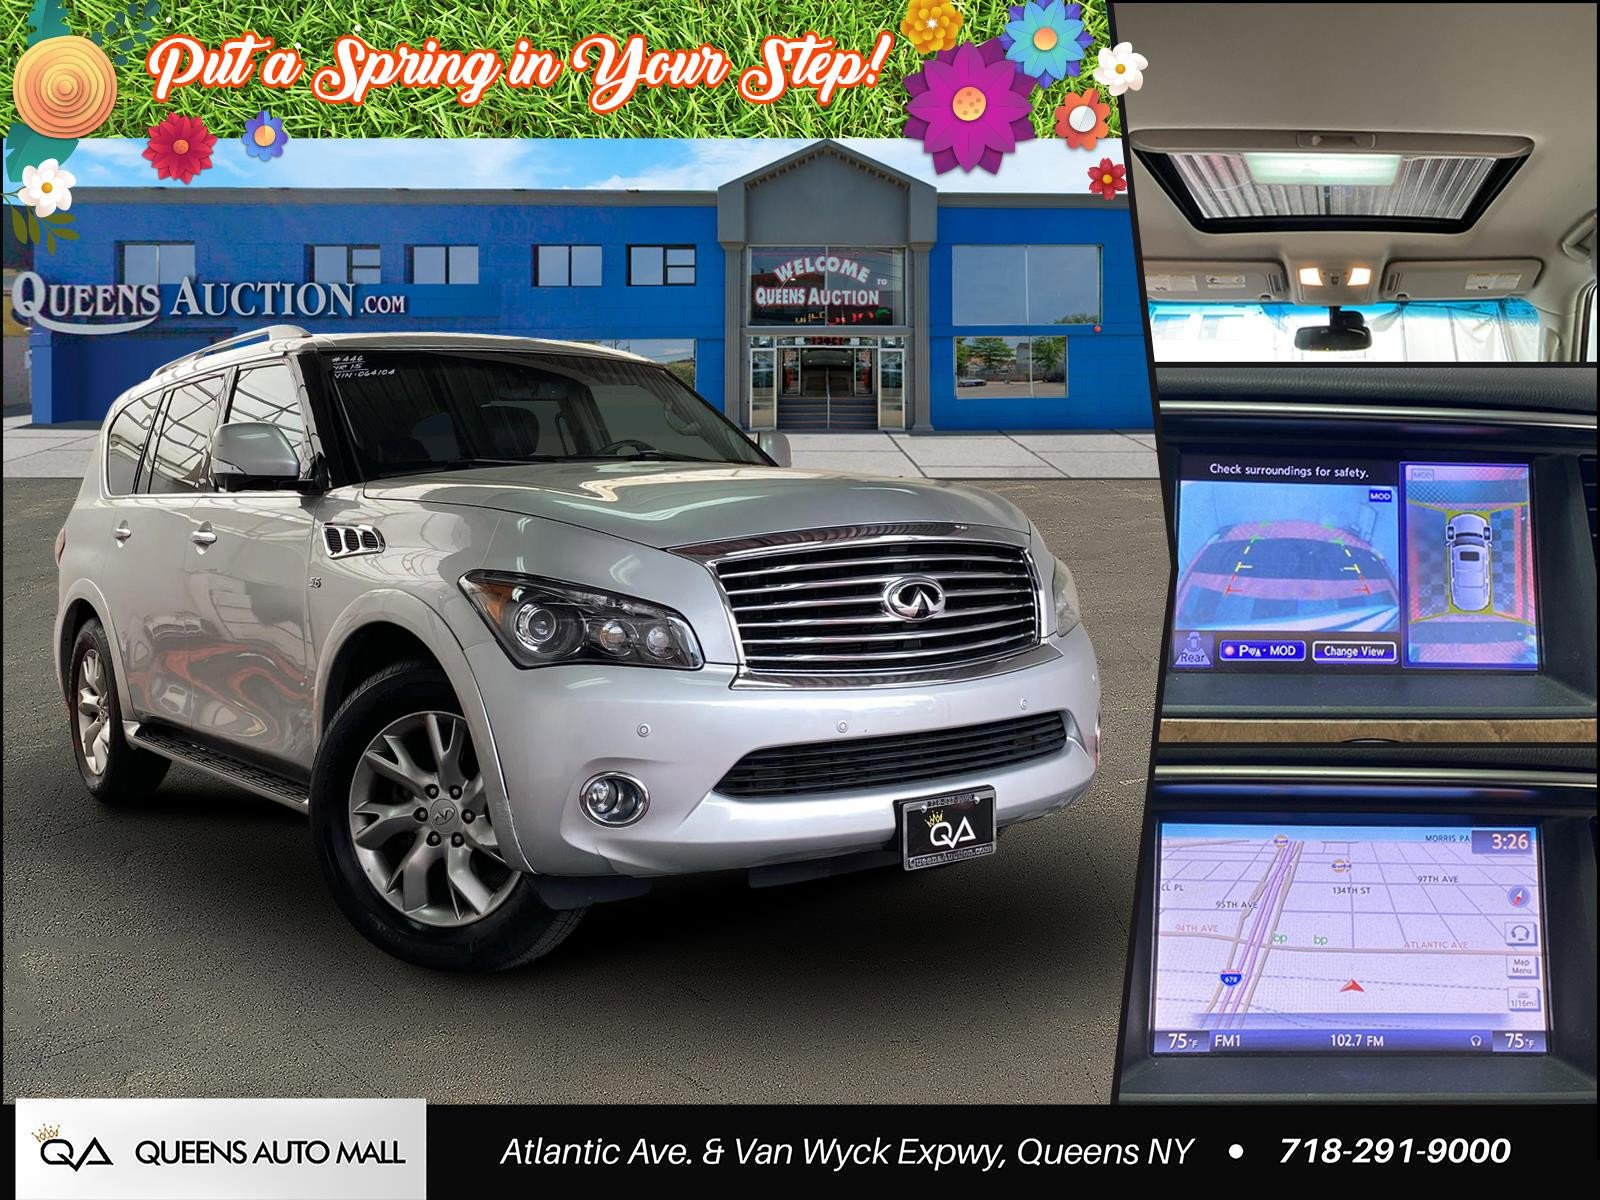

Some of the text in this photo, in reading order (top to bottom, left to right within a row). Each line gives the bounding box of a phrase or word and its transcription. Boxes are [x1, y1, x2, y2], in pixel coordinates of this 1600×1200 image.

[774, 256, 871, 283] WELCOME
[755, 287, 879, 306] QUEENS AUCTION
[11, 271, 161, 335] QUEENS
[169, 276, 355, 317] AUCTION
[1210, 463, 1369, 479] Check surroundings for safety.
[1370, 492, 1391, 500] MOD
[1270, 645, 1296, 656] MOD
[1324, 645, 1385, 658] Change View
[1181, 652, 1206, 663] Rear
[1491, 833, 1529, 850] 3:26
[1332, 887, 1357, 895] 134TH
[1273, 933, 1288, 943] bp
[1313, 935, 1328, 945] bp
[1403, 941, 1448, 949] ATLANTIC
[1513, 959, 1530, 967] Map
[1215, 1035, 1241, 1047] FM1
[1330, 1034, 1384, 1047] 102.7 FM
